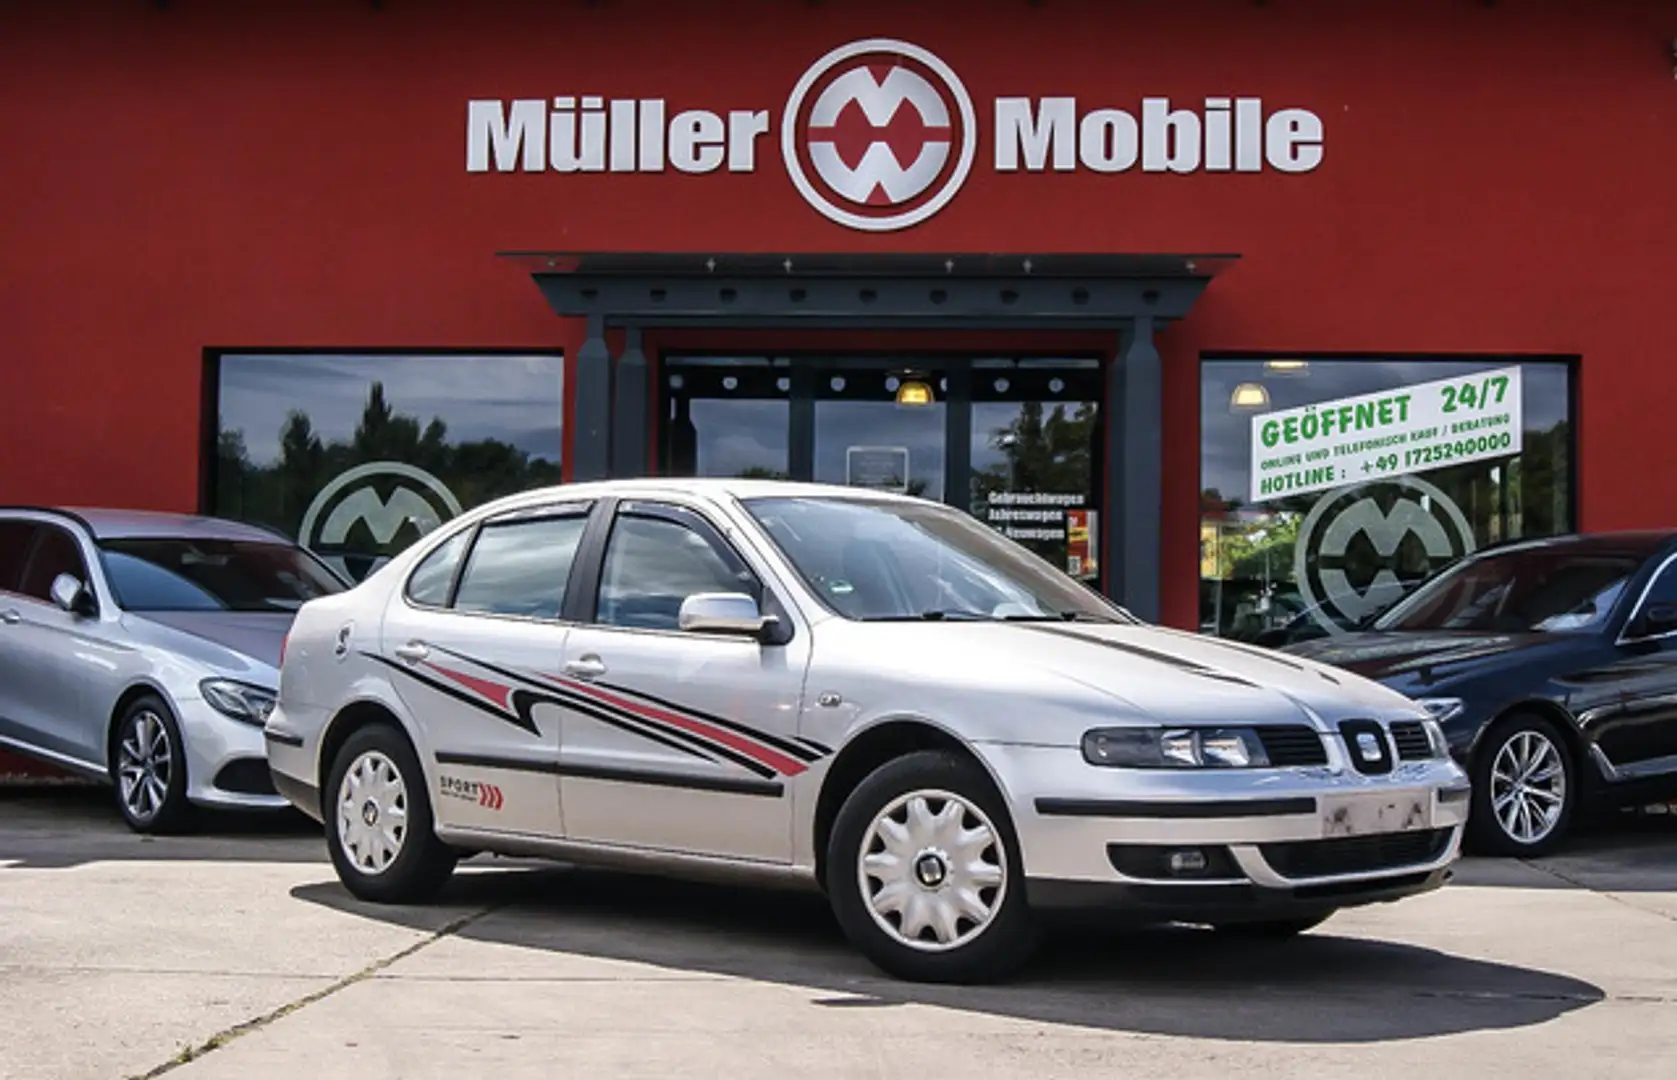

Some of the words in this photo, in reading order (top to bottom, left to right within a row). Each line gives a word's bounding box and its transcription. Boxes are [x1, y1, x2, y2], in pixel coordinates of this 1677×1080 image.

[466, 96, 769, 173] Müller
[994, 97, 1324, 173] Mobile
[1260, 453, 1302, 471] ONLINE
[1305, 448, 1330, 462] UND
[1333, 432, 1408, 457] TELEFONISCH
[1410, 426, 1438, 442] KAUF
[1451, 413, 1510, 434] BERATUNG
[1261, 394, 1411, 448] GEÖFFNET
[1440, 375, 1509, 413] 24/7
[1260, 465, 1335, 495] HOTLINE
[1360, 453, 1398, 473] +49
[1404, 431, 1511, 467] 1725240000
[987, 491, 1084, 507] Gebrauchtwagen
[987, 508, 1063, 523] Jahreswagen
[440, 775, 478, 795] SPORT
